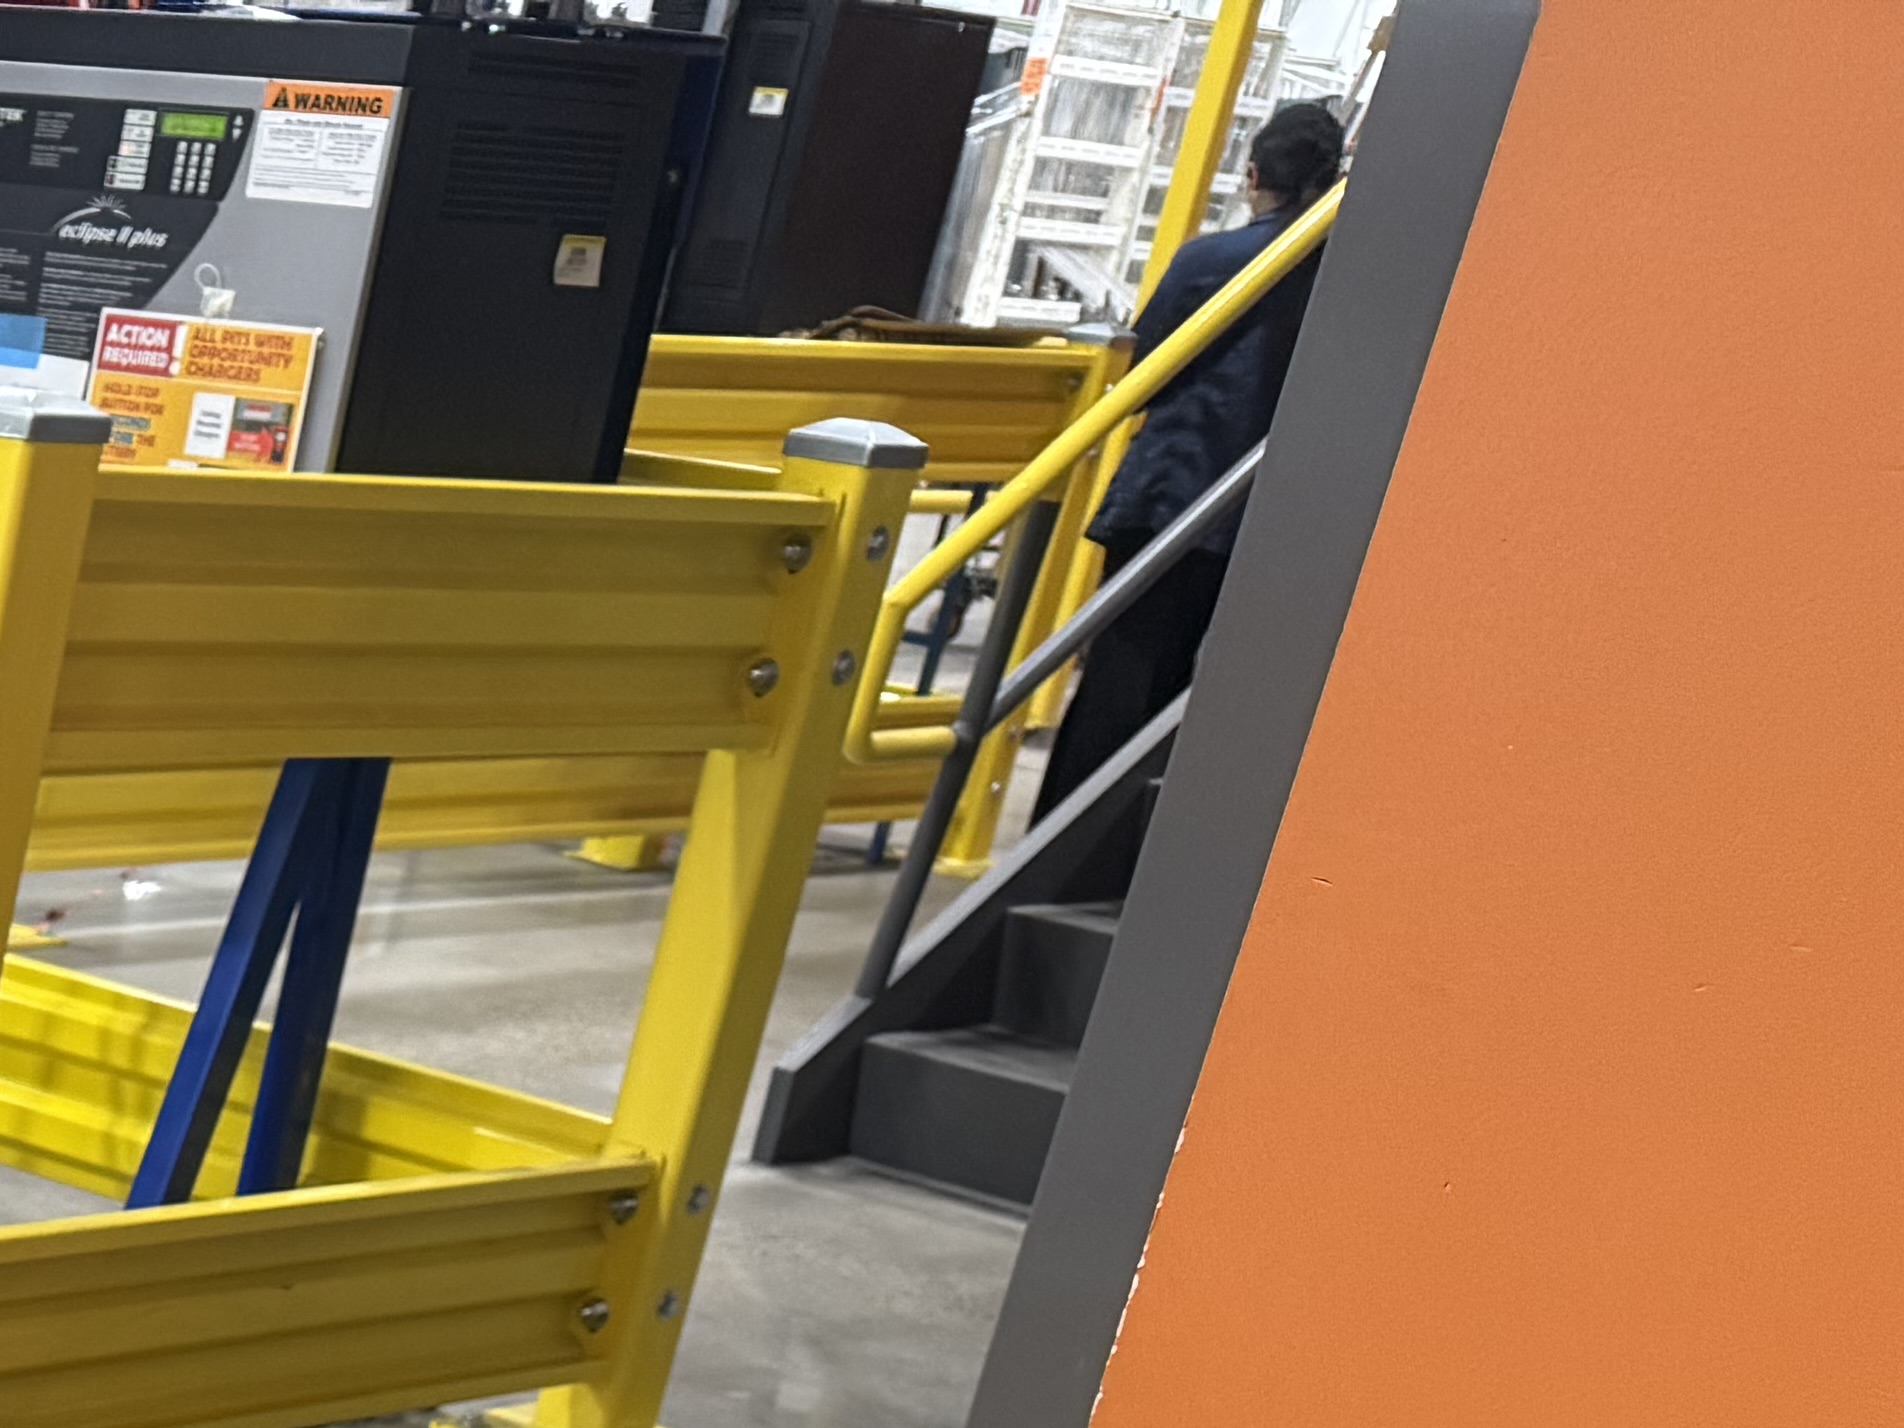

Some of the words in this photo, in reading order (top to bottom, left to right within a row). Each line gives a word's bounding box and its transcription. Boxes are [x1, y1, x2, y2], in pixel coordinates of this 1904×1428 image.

[294, 93, 383, 115] WARNING
[58, 222, 118, 244] eclipse
[127, 227, 168, 248] plus
[106, 323, 170, 349] ACTION
[102, 346, 169, 369] REQUIRED
